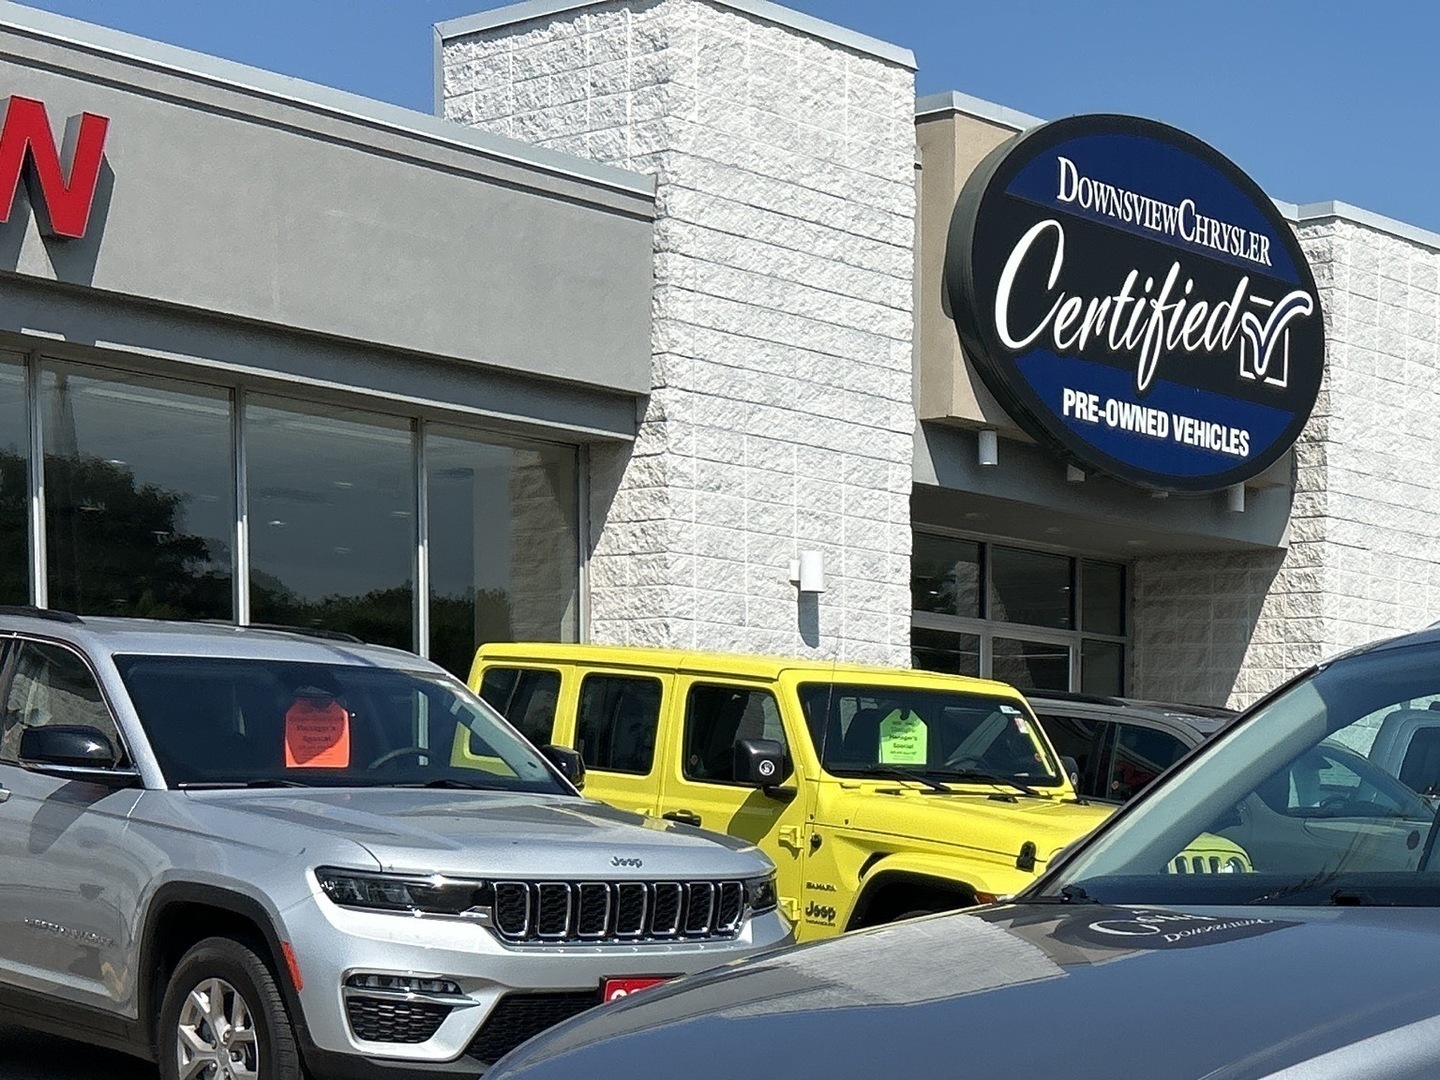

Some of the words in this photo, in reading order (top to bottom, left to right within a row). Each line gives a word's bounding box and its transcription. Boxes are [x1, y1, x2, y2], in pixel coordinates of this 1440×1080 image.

[995, 219, 1249, 391] Certified
[1063, 388, 1168, 438] PRE-OWNED
[1173, 415, 1250, 458] VEHICLES
[610, 856, 643, 869] Jeep
[805, 900, 836, 922] Jeep
